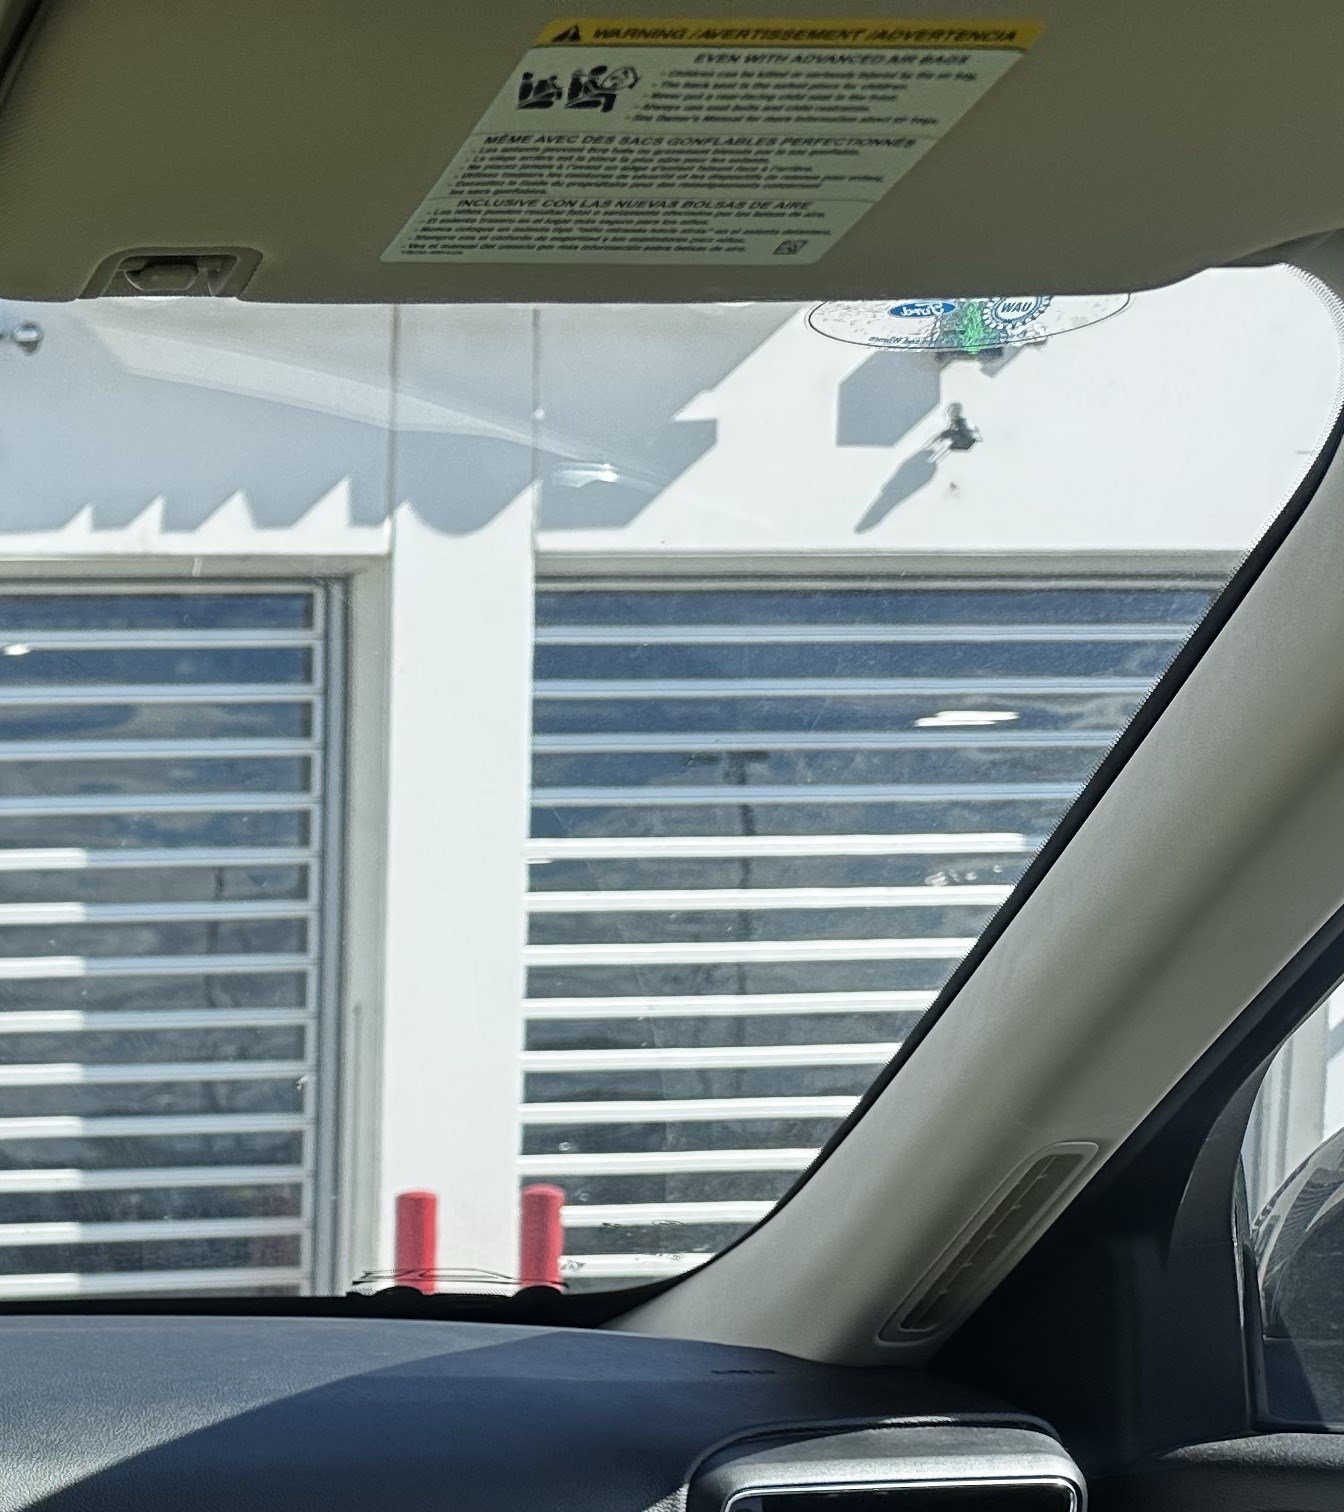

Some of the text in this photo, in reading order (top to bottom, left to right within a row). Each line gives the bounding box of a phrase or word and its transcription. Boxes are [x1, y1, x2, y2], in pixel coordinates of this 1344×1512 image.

[593, 28, 688, 40] WARNING
[693, 53, 743, 63] EVEN
[744, 53, 789, 64] WITH
[791, 54, 885, 65] ADVANCED
[887, 54, 916, 65] AIR
[535, 135, 578, 145] AVEC
[581, 136, 613, 145] DES
[617, 136, 664, 146] SACS
[457, 198, 814, 210] INCLUSIVE CON LAS NUEVAS BOLSAS DE AIRE
